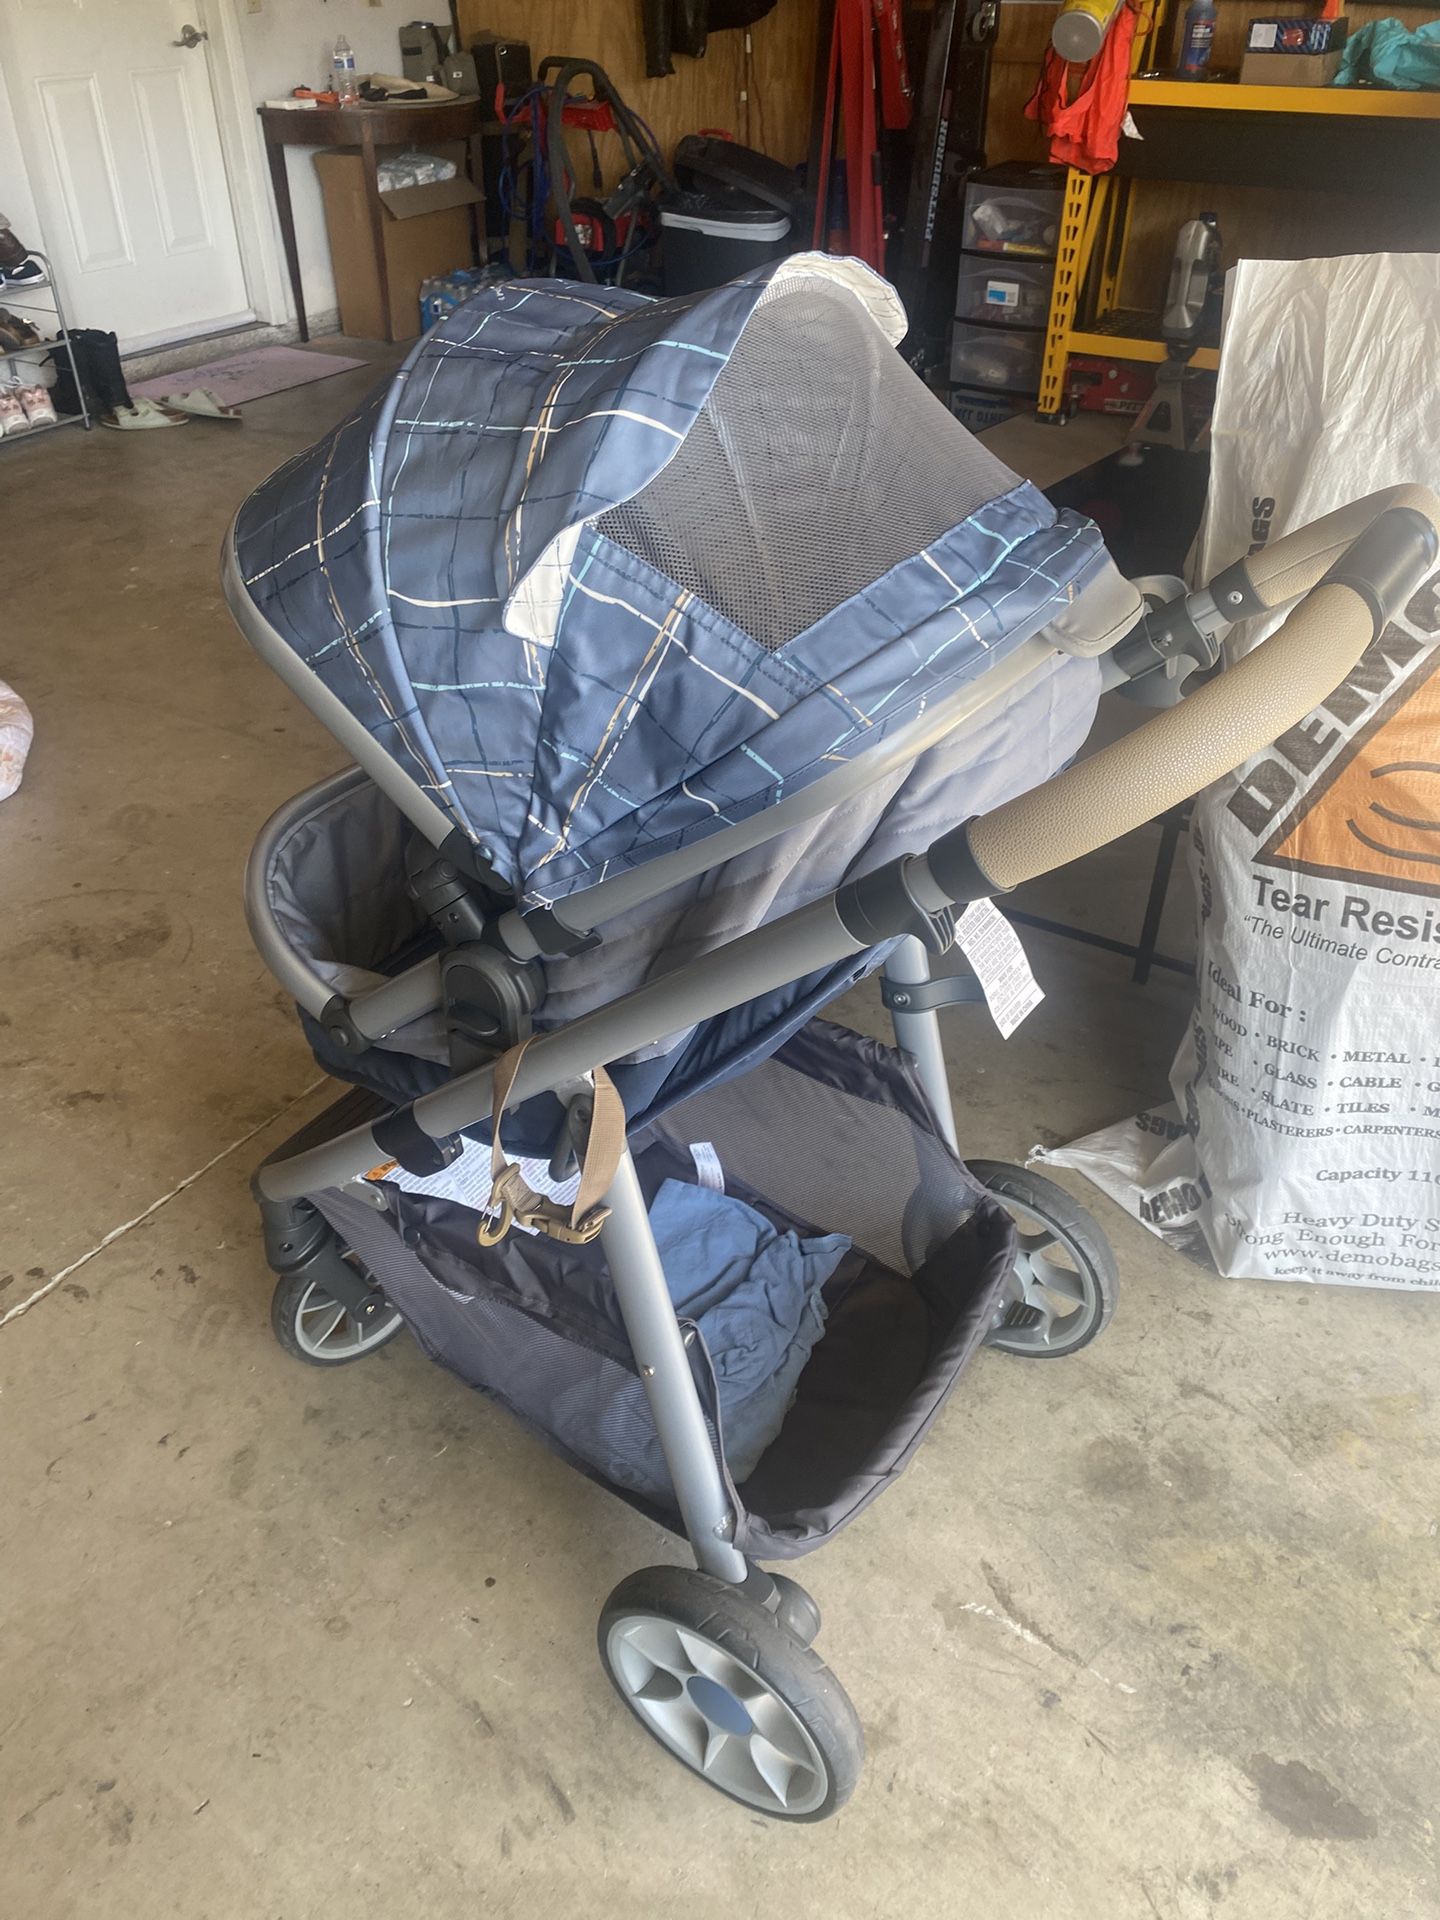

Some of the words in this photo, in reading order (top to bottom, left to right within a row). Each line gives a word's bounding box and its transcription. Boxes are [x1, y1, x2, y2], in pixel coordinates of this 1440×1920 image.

[1252, 874, 1330, 921] Tear
[1291, 925, 1368, 960] Ultimate
[1208, 961, 1242, 1003] Ideal
[1267, 1035, 1320, 1062] BRICK
[1343, 1051, 1411, 1064] METAL
[1264, 1063, 1317, 1089] GLASS
[1340, 1077, 1402, 1088] CABLE
[1261, 1090, 1315, 1116] SLATE
[1337, 1102, 1390, 1113] TILES
[1316, 1167, 1402, 1183] Capacity
[1282, 1212, 1356, 1229] Heavy
[1360, 1213, 1419, 1231] Duty
[1296, 1229, 1385, 1249] Enough
[1367, 1272, 1406, 1284] from
